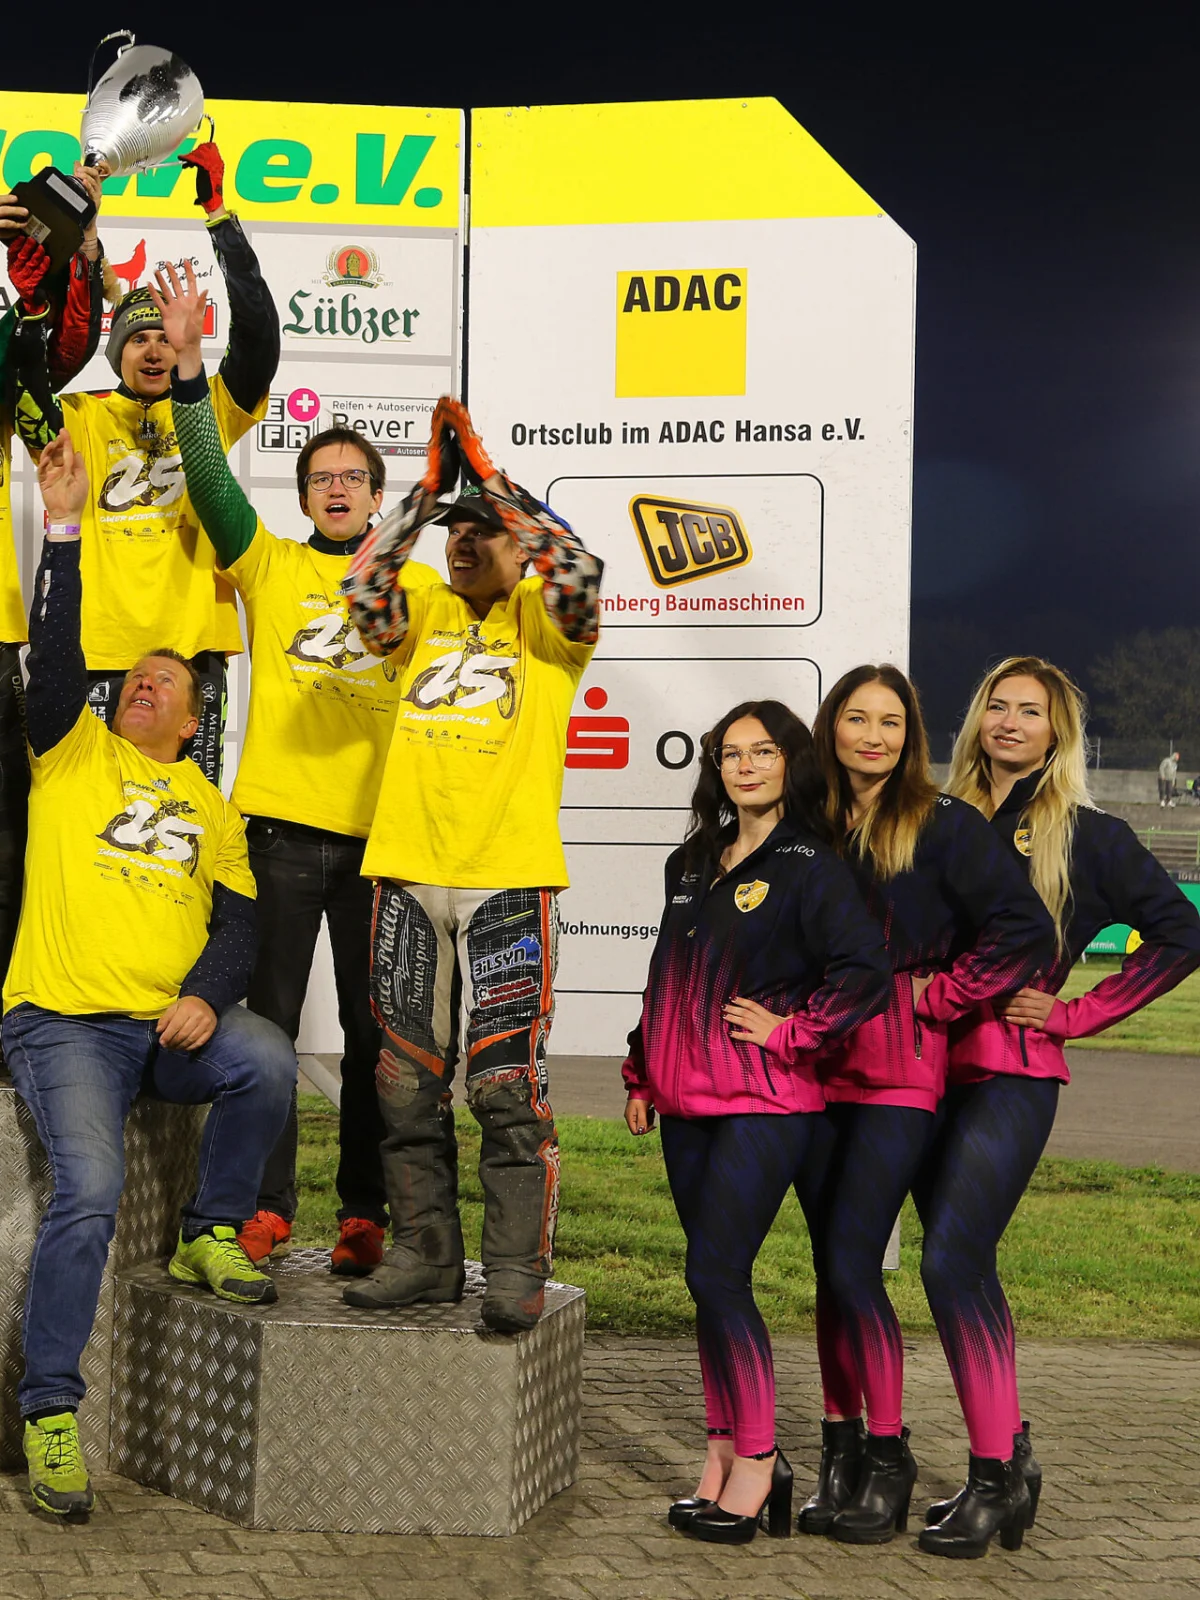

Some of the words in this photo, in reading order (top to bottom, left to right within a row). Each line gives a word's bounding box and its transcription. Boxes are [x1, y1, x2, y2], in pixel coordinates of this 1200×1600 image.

[235, 132, 443, 208] e.V.
[282, 289, 421, 343] Lübzer
[623, 273, 742, 313] ADAC
[332, 400, 365, 411] Reifen
[376, 402, 436, 413] Autoservice
[511, 422, 612, 446] Ortsclub
[621, 421, 650, 445] im
[658, 420, 725, 444] ADAC
[735, 418, 812, 443] Hansa
[821, 417, 866, 441] e.V.
[107, 454, 186, 507] 25
[657, 510, 736, 573] JCB
[666, 594, 805, 612] Baumaschinen
[419, 650, 519, 709] 25
[113, 799, 204, 863] 25
[407, 926, 428, 1011] Transport
